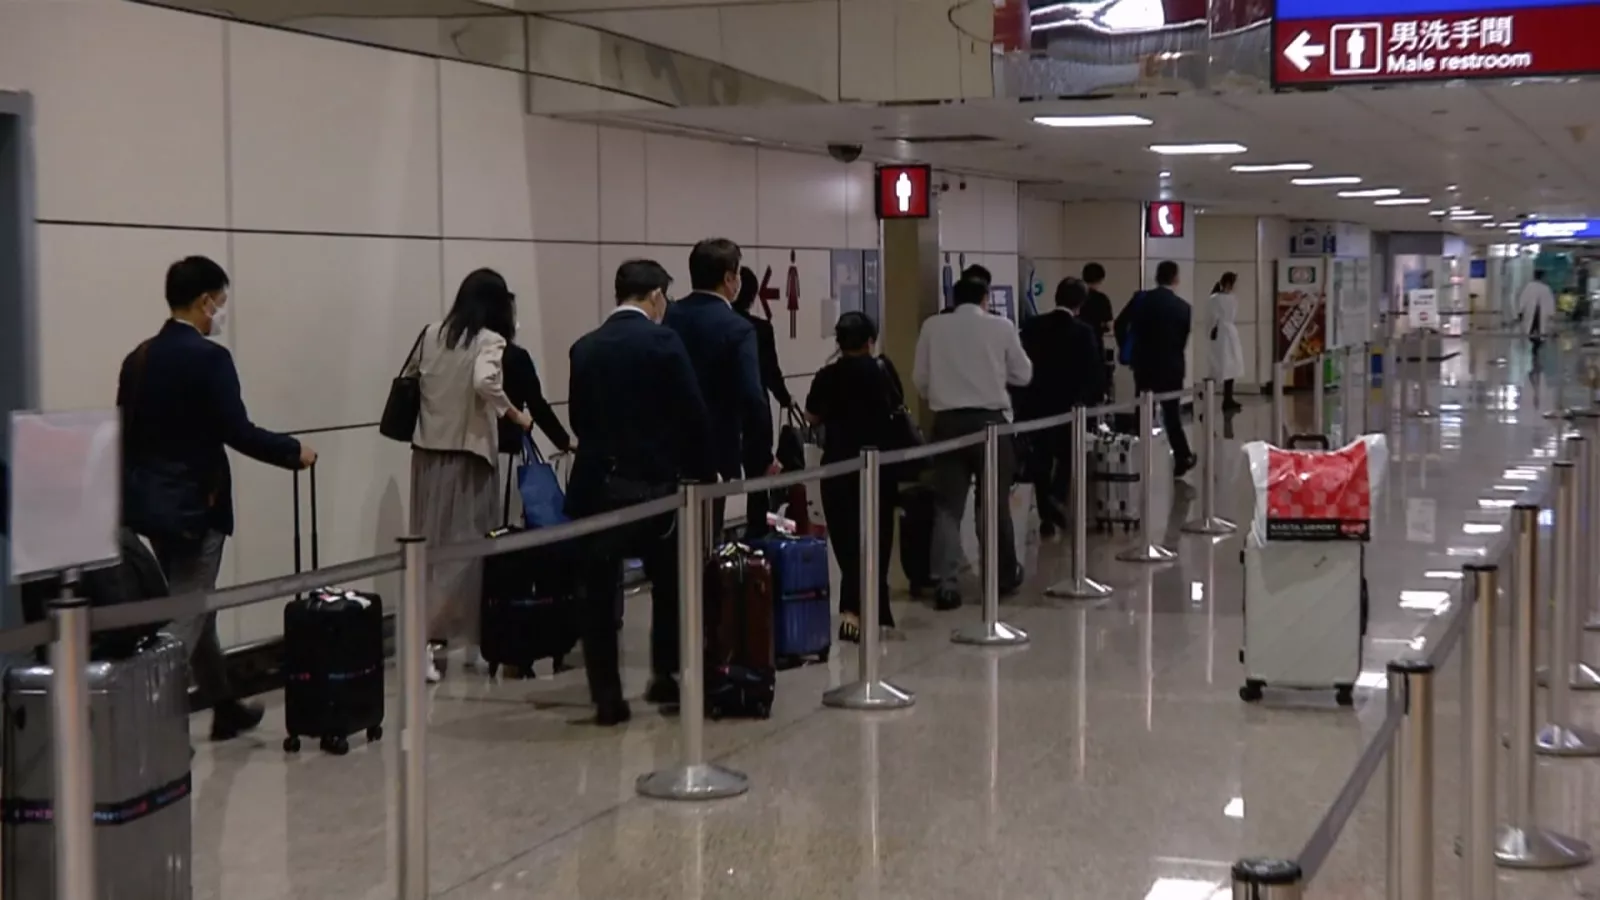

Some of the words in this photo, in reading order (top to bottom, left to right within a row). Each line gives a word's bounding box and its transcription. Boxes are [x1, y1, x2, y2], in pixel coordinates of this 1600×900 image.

[1388, 16, 1513, 52] 男洗手間
[1387, 53, 1435, 73] Male
[1440, 51, 1532, 70] restroom
